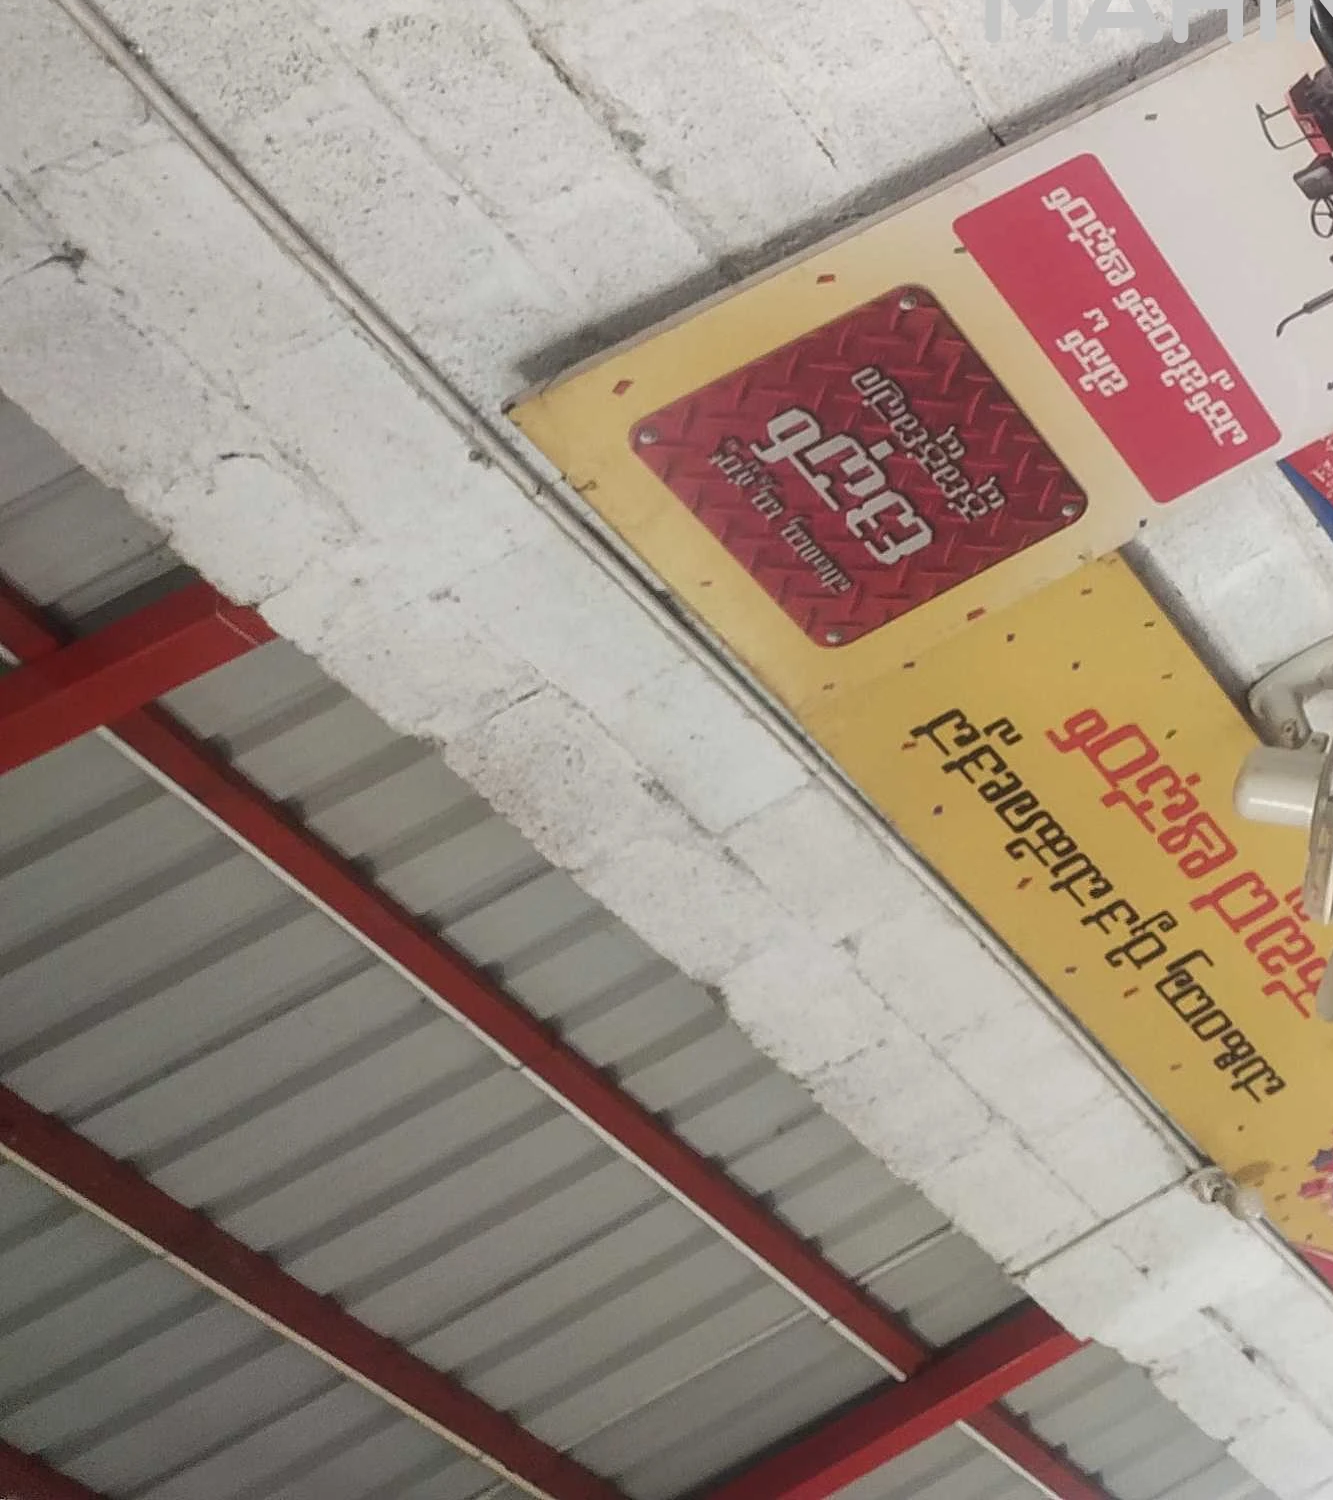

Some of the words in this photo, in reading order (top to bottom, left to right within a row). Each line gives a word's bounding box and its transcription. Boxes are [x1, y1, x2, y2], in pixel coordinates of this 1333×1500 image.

[1038, 189, 1139, 289] ಆಫರ್
[1054, 305, 1130, 398] ಬೆಸ್ಟ್
[748, 404, 936, 571] ಟಫ್
[908, 700, 1115, 904] ಮಹೋತ್ಸವ
[1042, 704, 1241, 881] ಆಫರ್
[1079, 893, 1178, 974] ರೈತ
